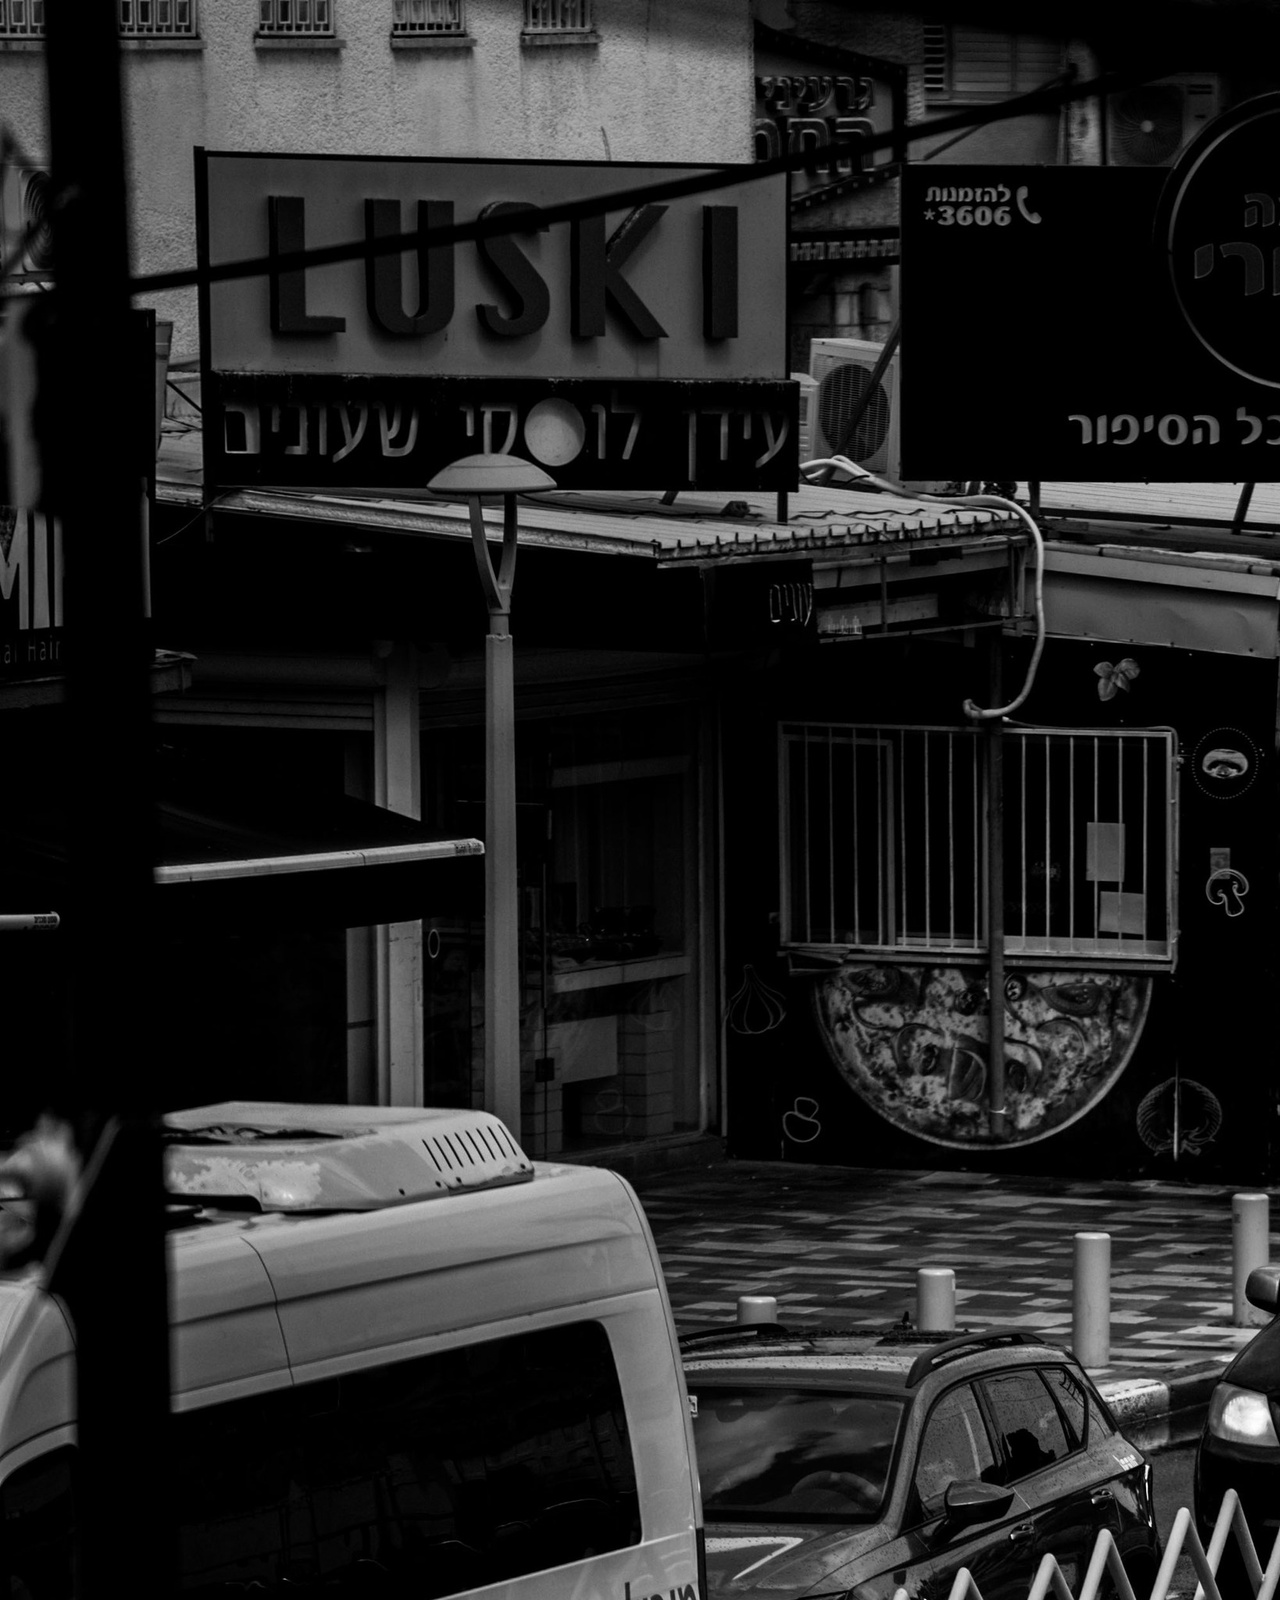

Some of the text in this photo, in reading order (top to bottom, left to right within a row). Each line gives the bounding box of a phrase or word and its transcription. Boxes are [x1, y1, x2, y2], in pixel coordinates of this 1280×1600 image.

[924, 183, 1012, 203] להזמנות
[268, 195, 738, 340] LUSKI
[223, 399, 420, 463] שעונים
[1067, 413, 1221, 446] הסיפור
